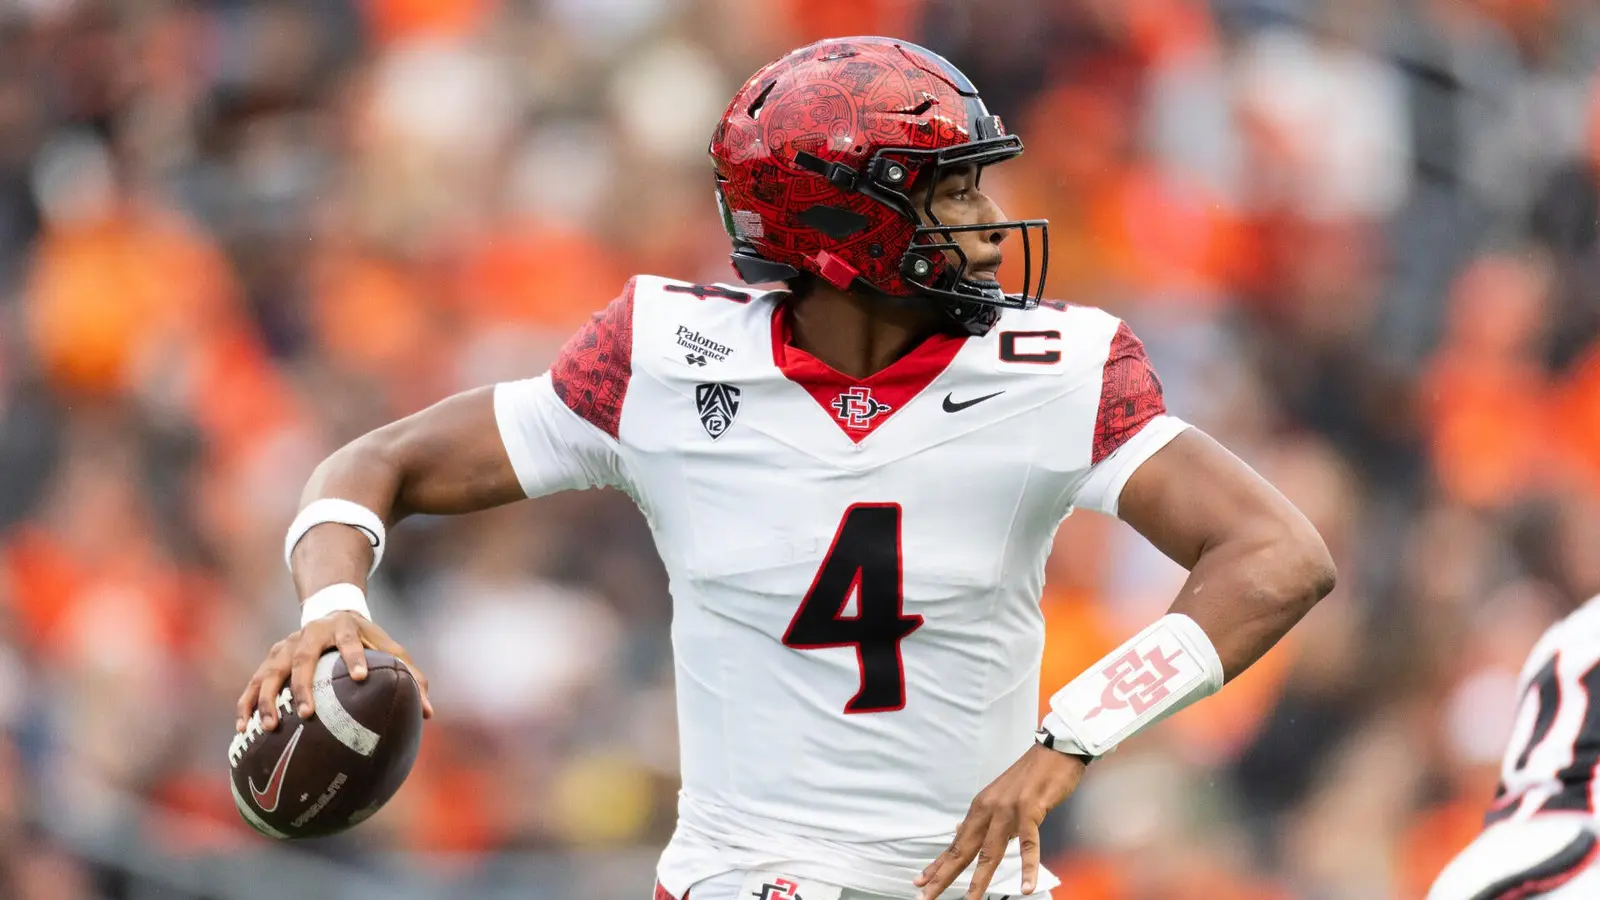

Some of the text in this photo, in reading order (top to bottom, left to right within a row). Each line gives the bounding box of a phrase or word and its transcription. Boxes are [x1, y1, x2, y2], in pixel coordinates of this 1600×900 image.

[675, 324, 734, 356] Palomar
[676, 336, 725, 363] Insurance
[999, 330, 1062, 364] C
[696, 383, 741, 418] PAC
[709, 420, 722, 432] 12
[782, 502, 924, 714] 4
